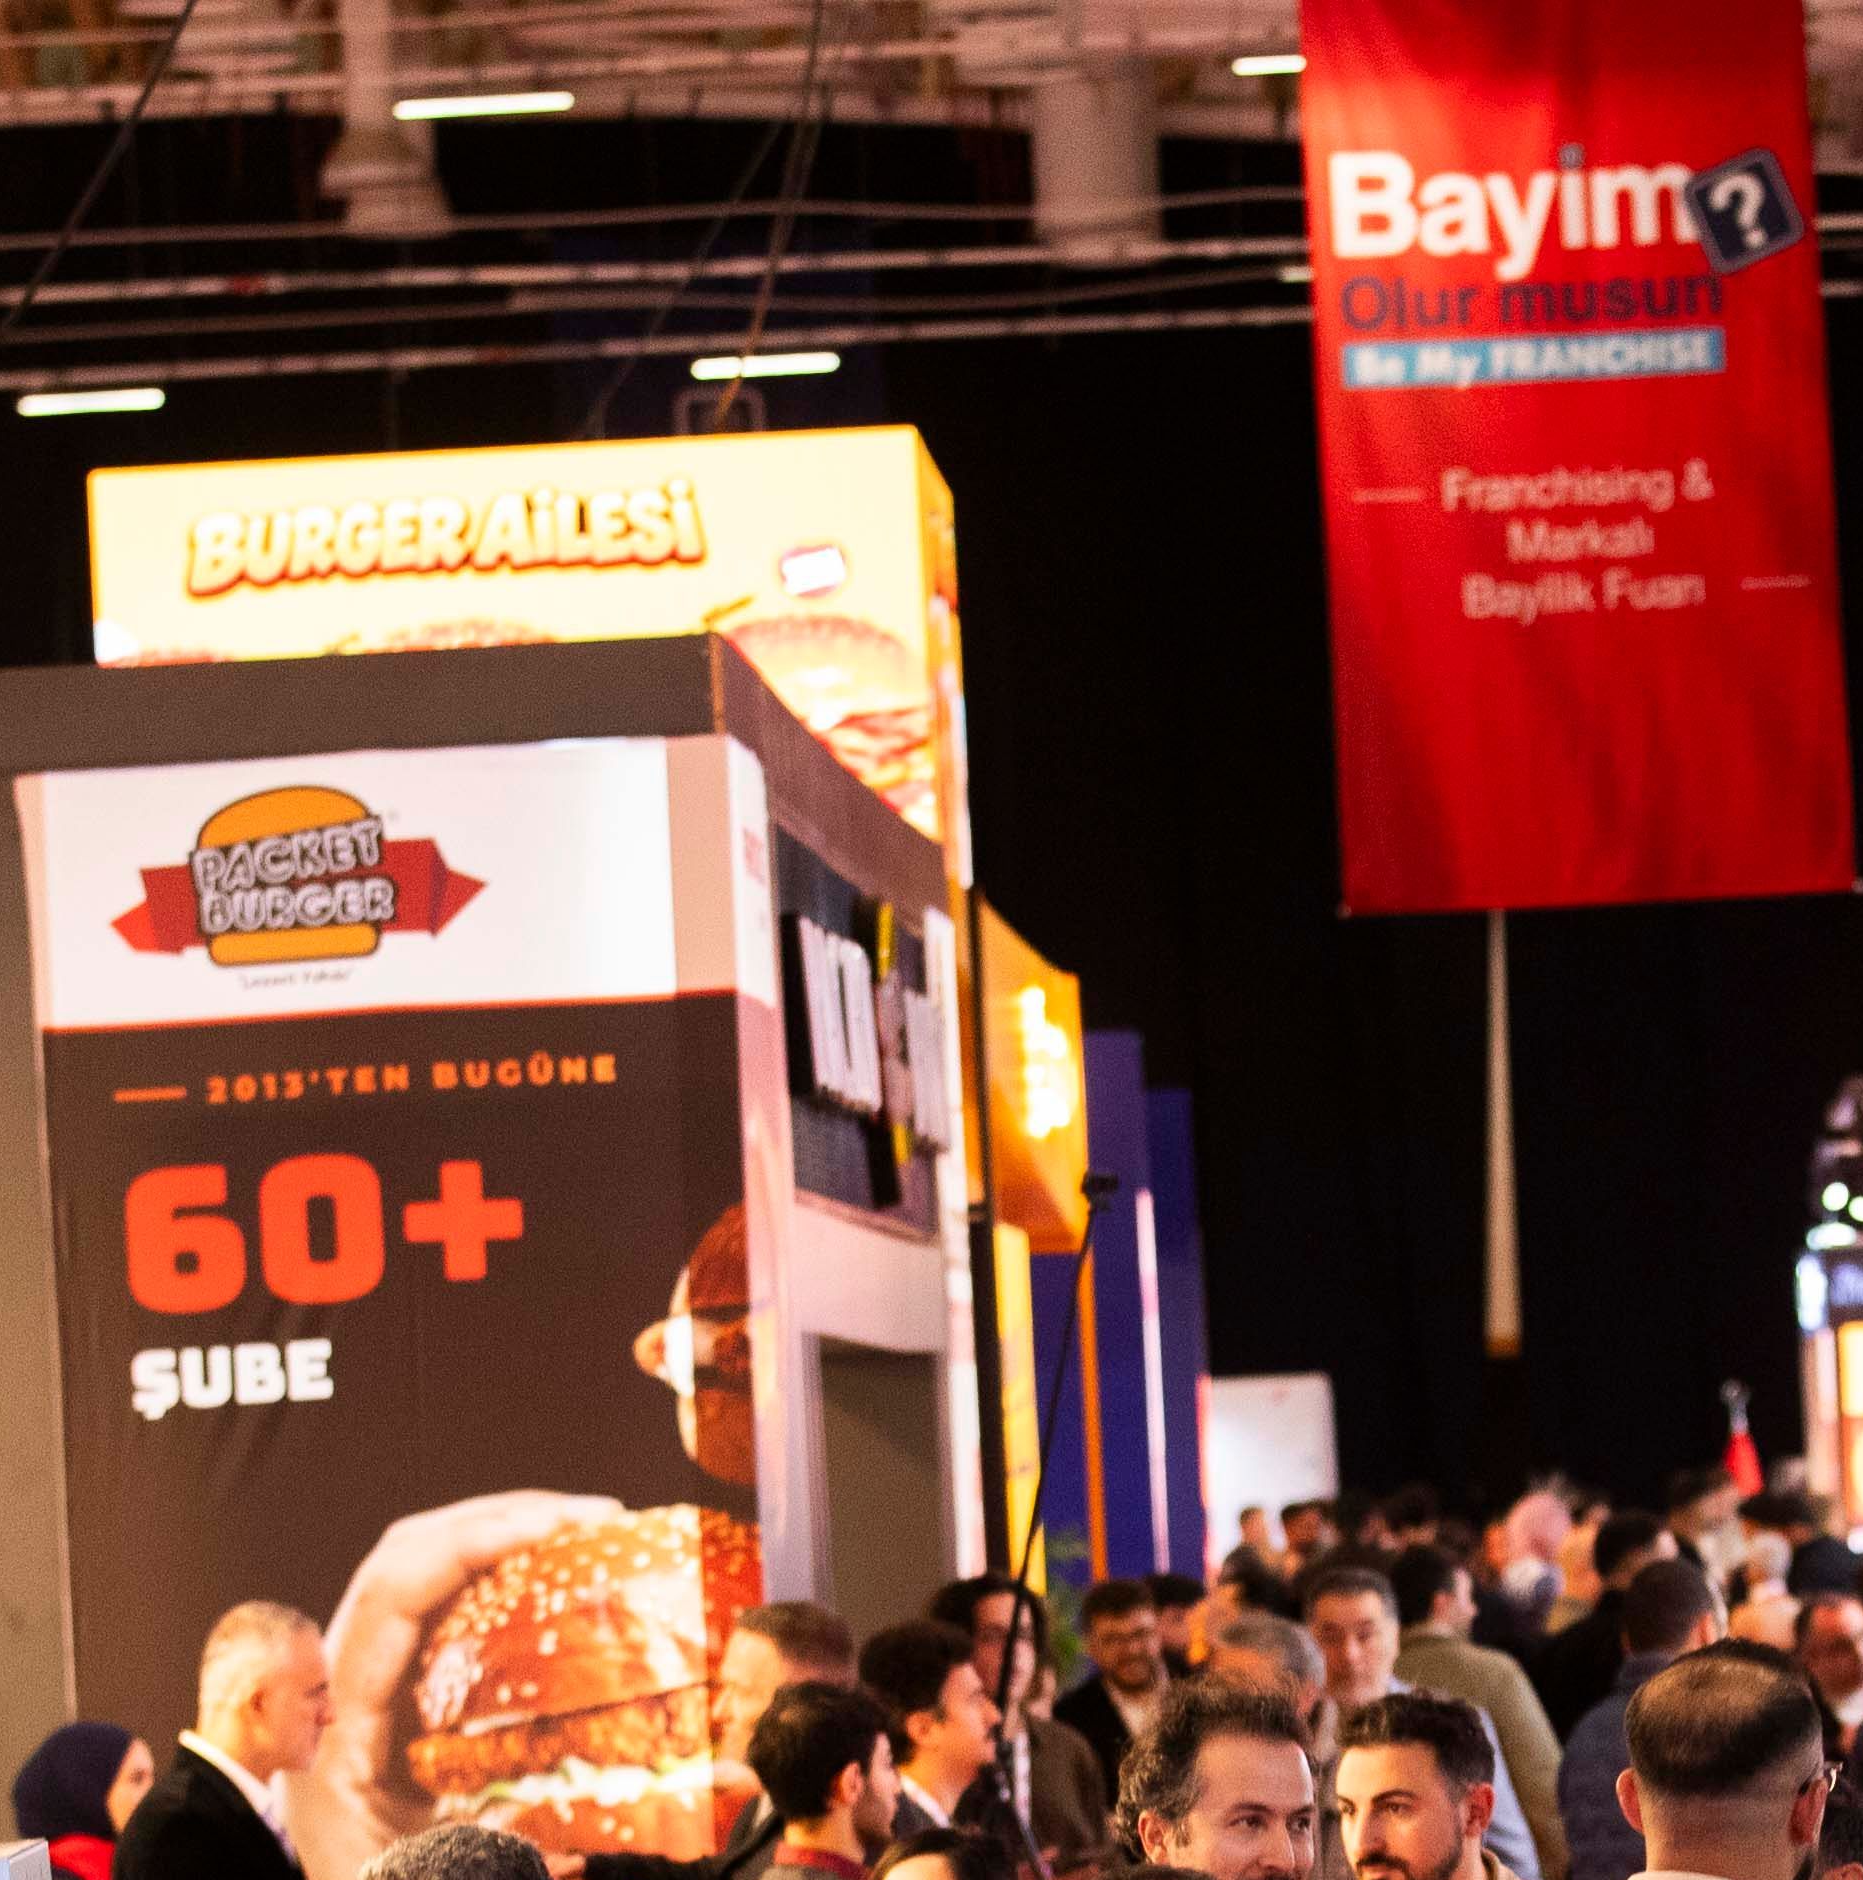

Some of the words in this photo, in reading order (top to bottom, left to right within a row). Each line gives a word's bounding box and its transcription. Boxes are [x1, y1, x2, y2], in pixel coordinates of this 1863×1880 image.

[1340, 274, 1475, 332] Olur
[1499, 270, 1725, 324] musun
[187, 495, 471, 600] BURGER
[190, 815, 383, 895] PACKET
[200, 873, 396, 936] BURGER
[206, 1062, 410, 1105] 2013'TEN
[432, 1048, 618, 1091] BUGÜNE
[124, 1152, 525, 1316] 60+
[129, 1337, 335, 1421] ŞUBE
